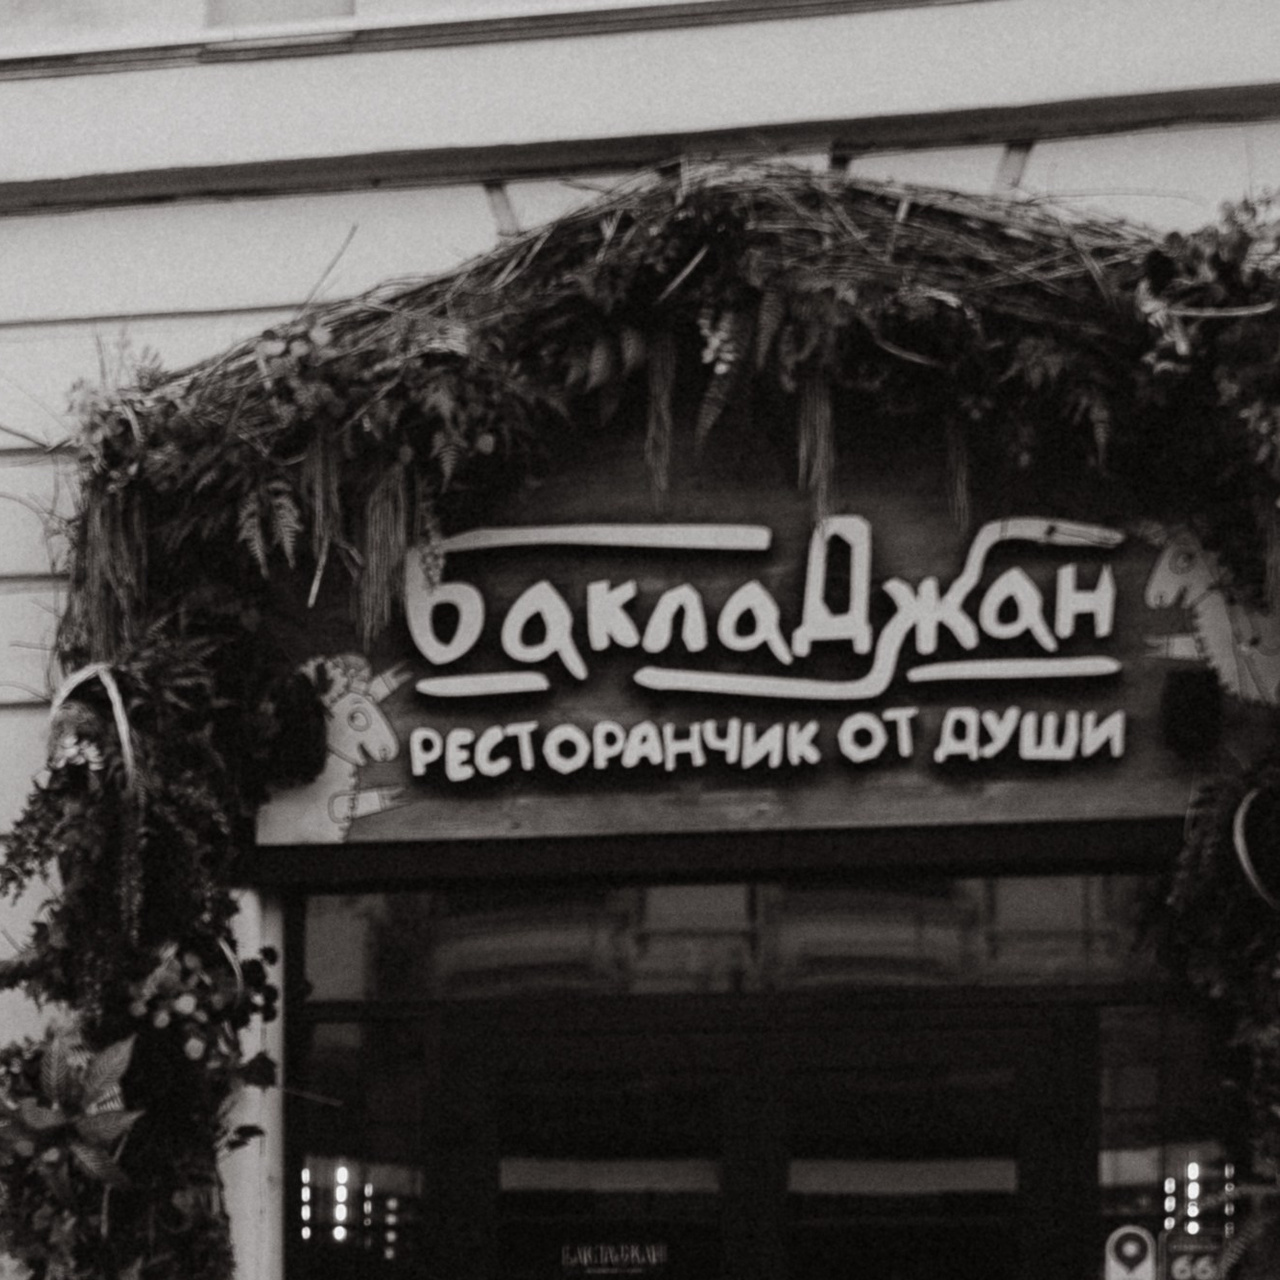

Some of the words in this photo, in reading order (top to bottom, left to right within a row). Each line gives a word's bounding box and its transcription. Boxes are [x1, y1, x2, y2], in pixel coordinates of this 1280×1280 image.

[411, 719, 819, 780] РЕСТОРАНЧИК
[838, 708, 917, 761] ОТ
[935, 708, 1123, 761] ДУШИ
